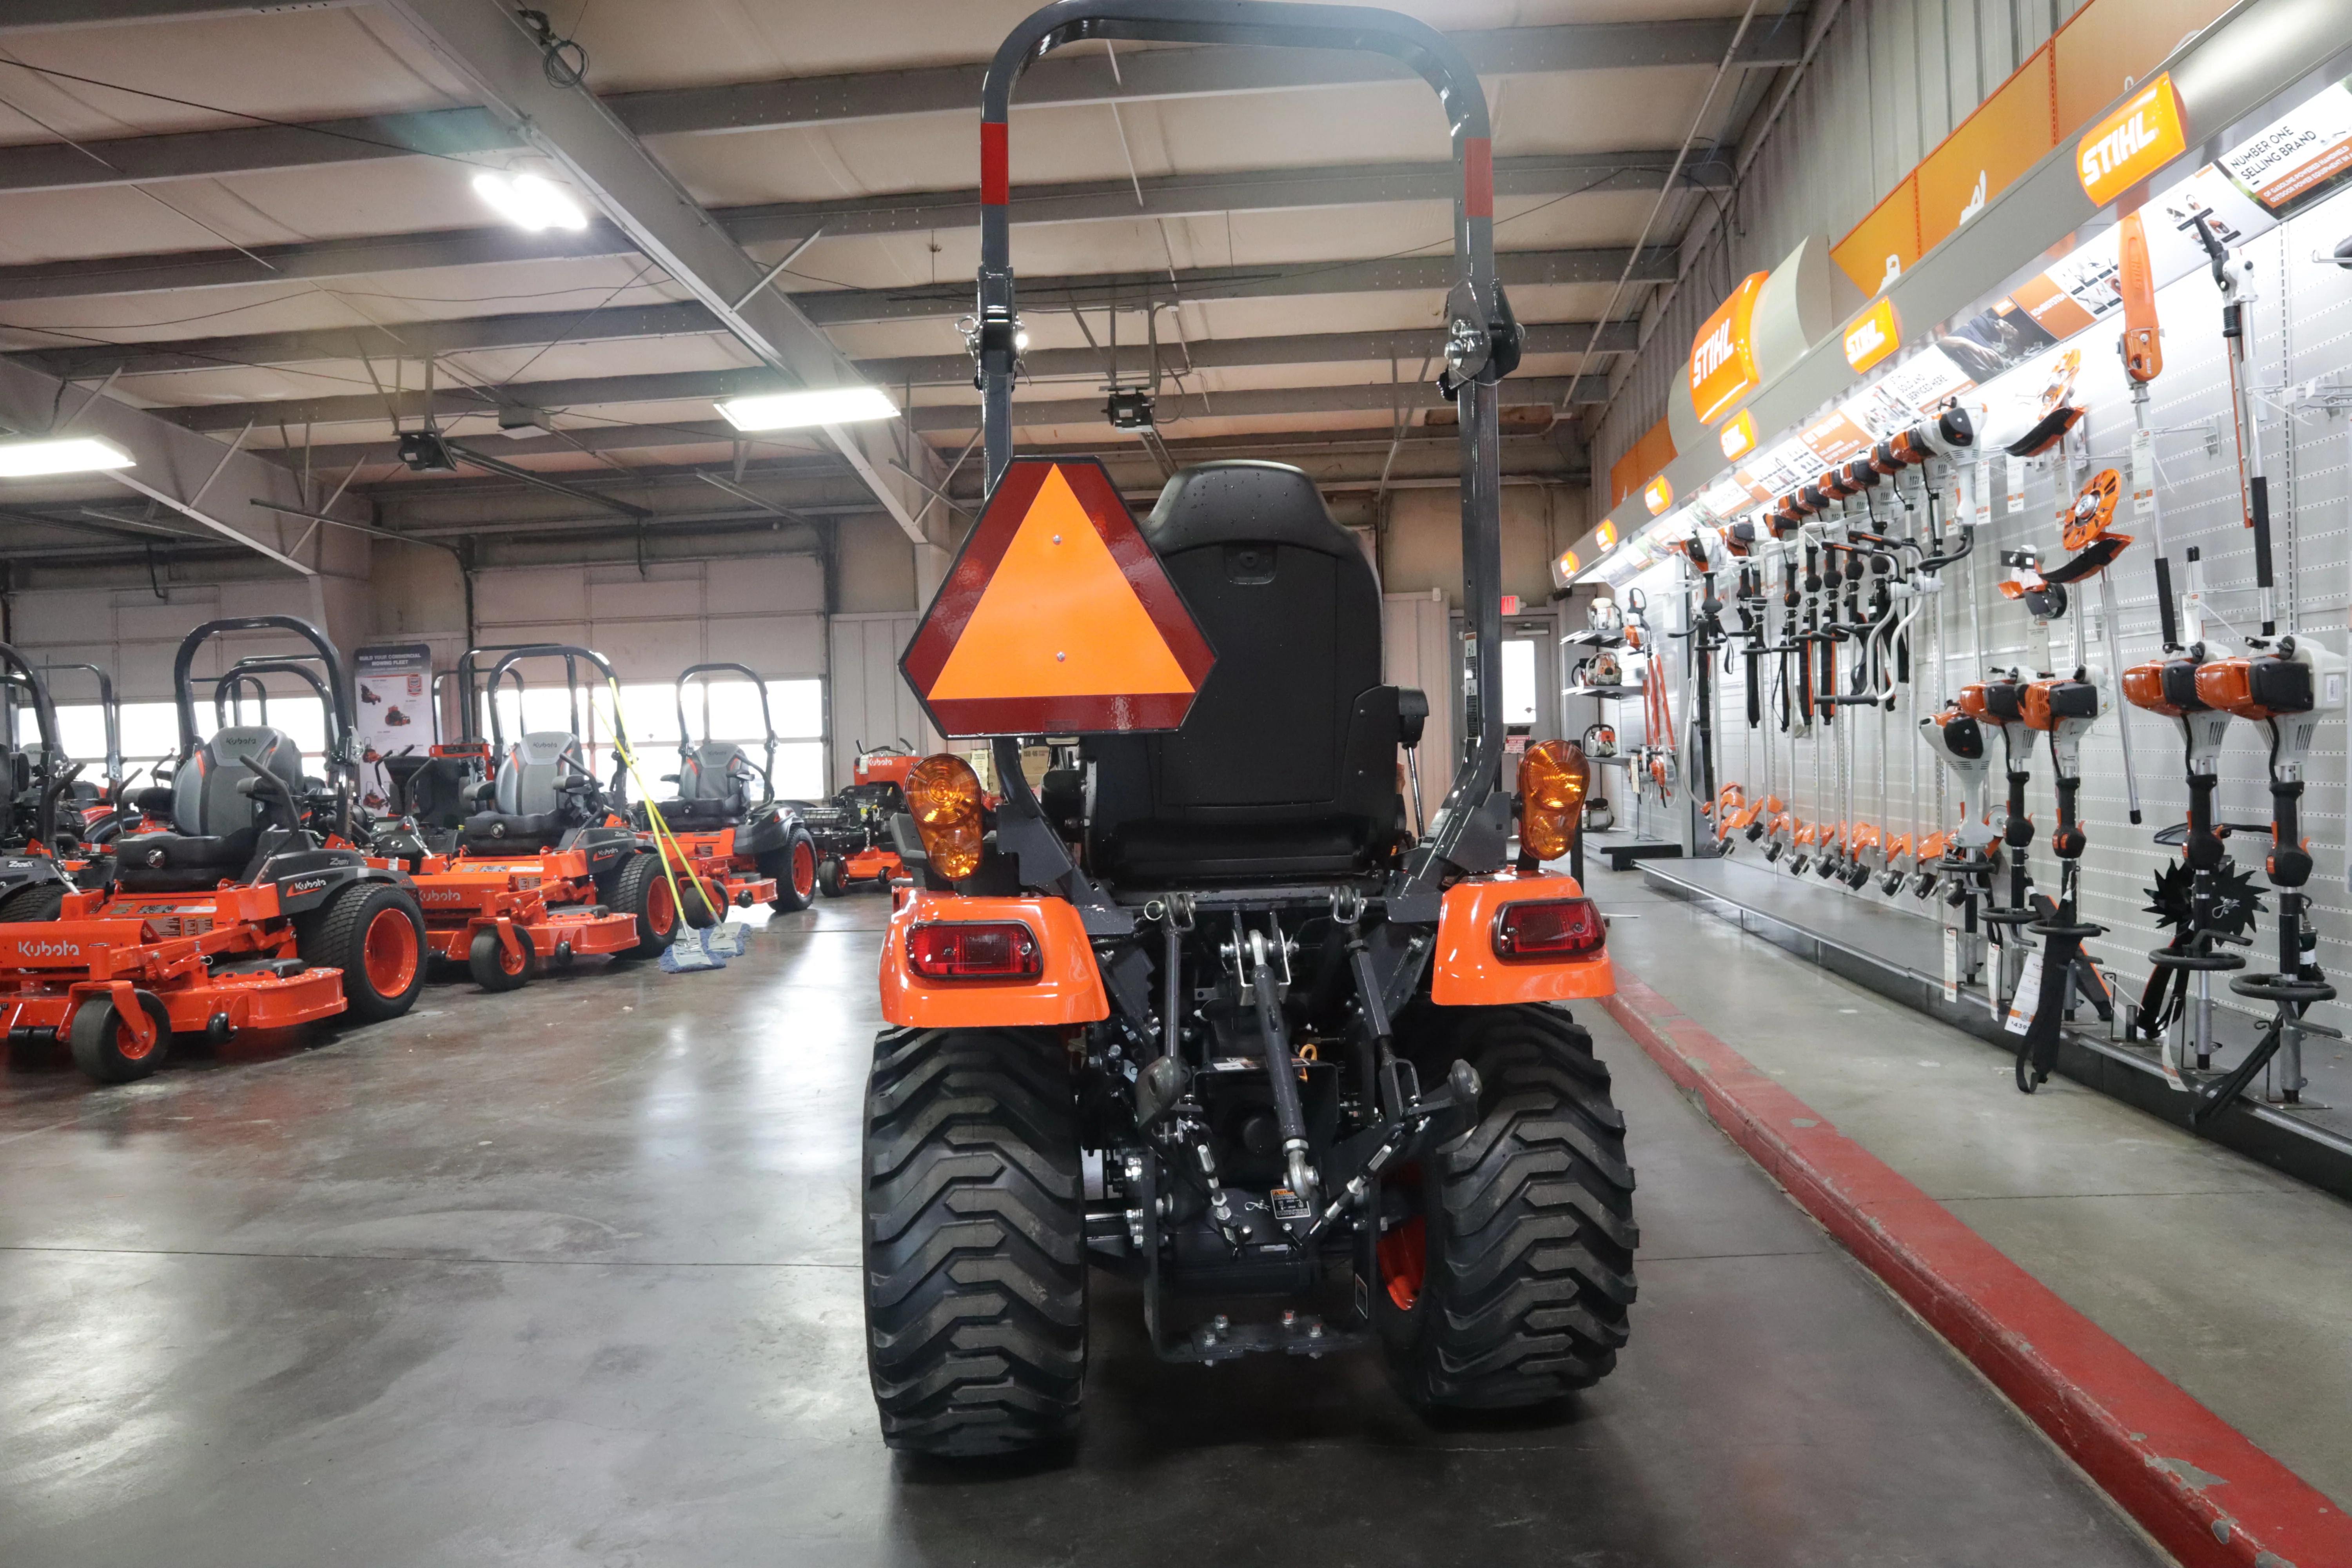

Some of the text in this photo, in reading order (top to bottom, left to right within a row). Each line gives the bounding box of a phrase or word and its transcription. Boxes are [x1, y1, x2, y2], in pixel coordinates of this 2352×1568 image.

[2082, 111, 2157, 186] STIHL
[2230, 140, 2271, 169] NUMBER
[2269, 126, 2294, 144] ONE
[2241, 152, 2281, 180] SELLING
[2278, 131, 2317, 156] BRAND
[2270, 186, 2297, 202] OUTDOOR
[2293, 176, 2314, 189] POWER
[2311, 158, 2344, 179] EQUIPMENT
[2131, 260, 2142, 291] STIHL
[1693, 318, 1734, 389] STIHL
[1906, 383, 1932, 401] SERVICED
[1501, 596, 1516, 614] XIT
[869, 758, 893, 766] Kubota
[598, 847, 619, 855] Kubota
[295, 878, 327, 890] Kubota
[18, 940, 80, 957] Kubota
